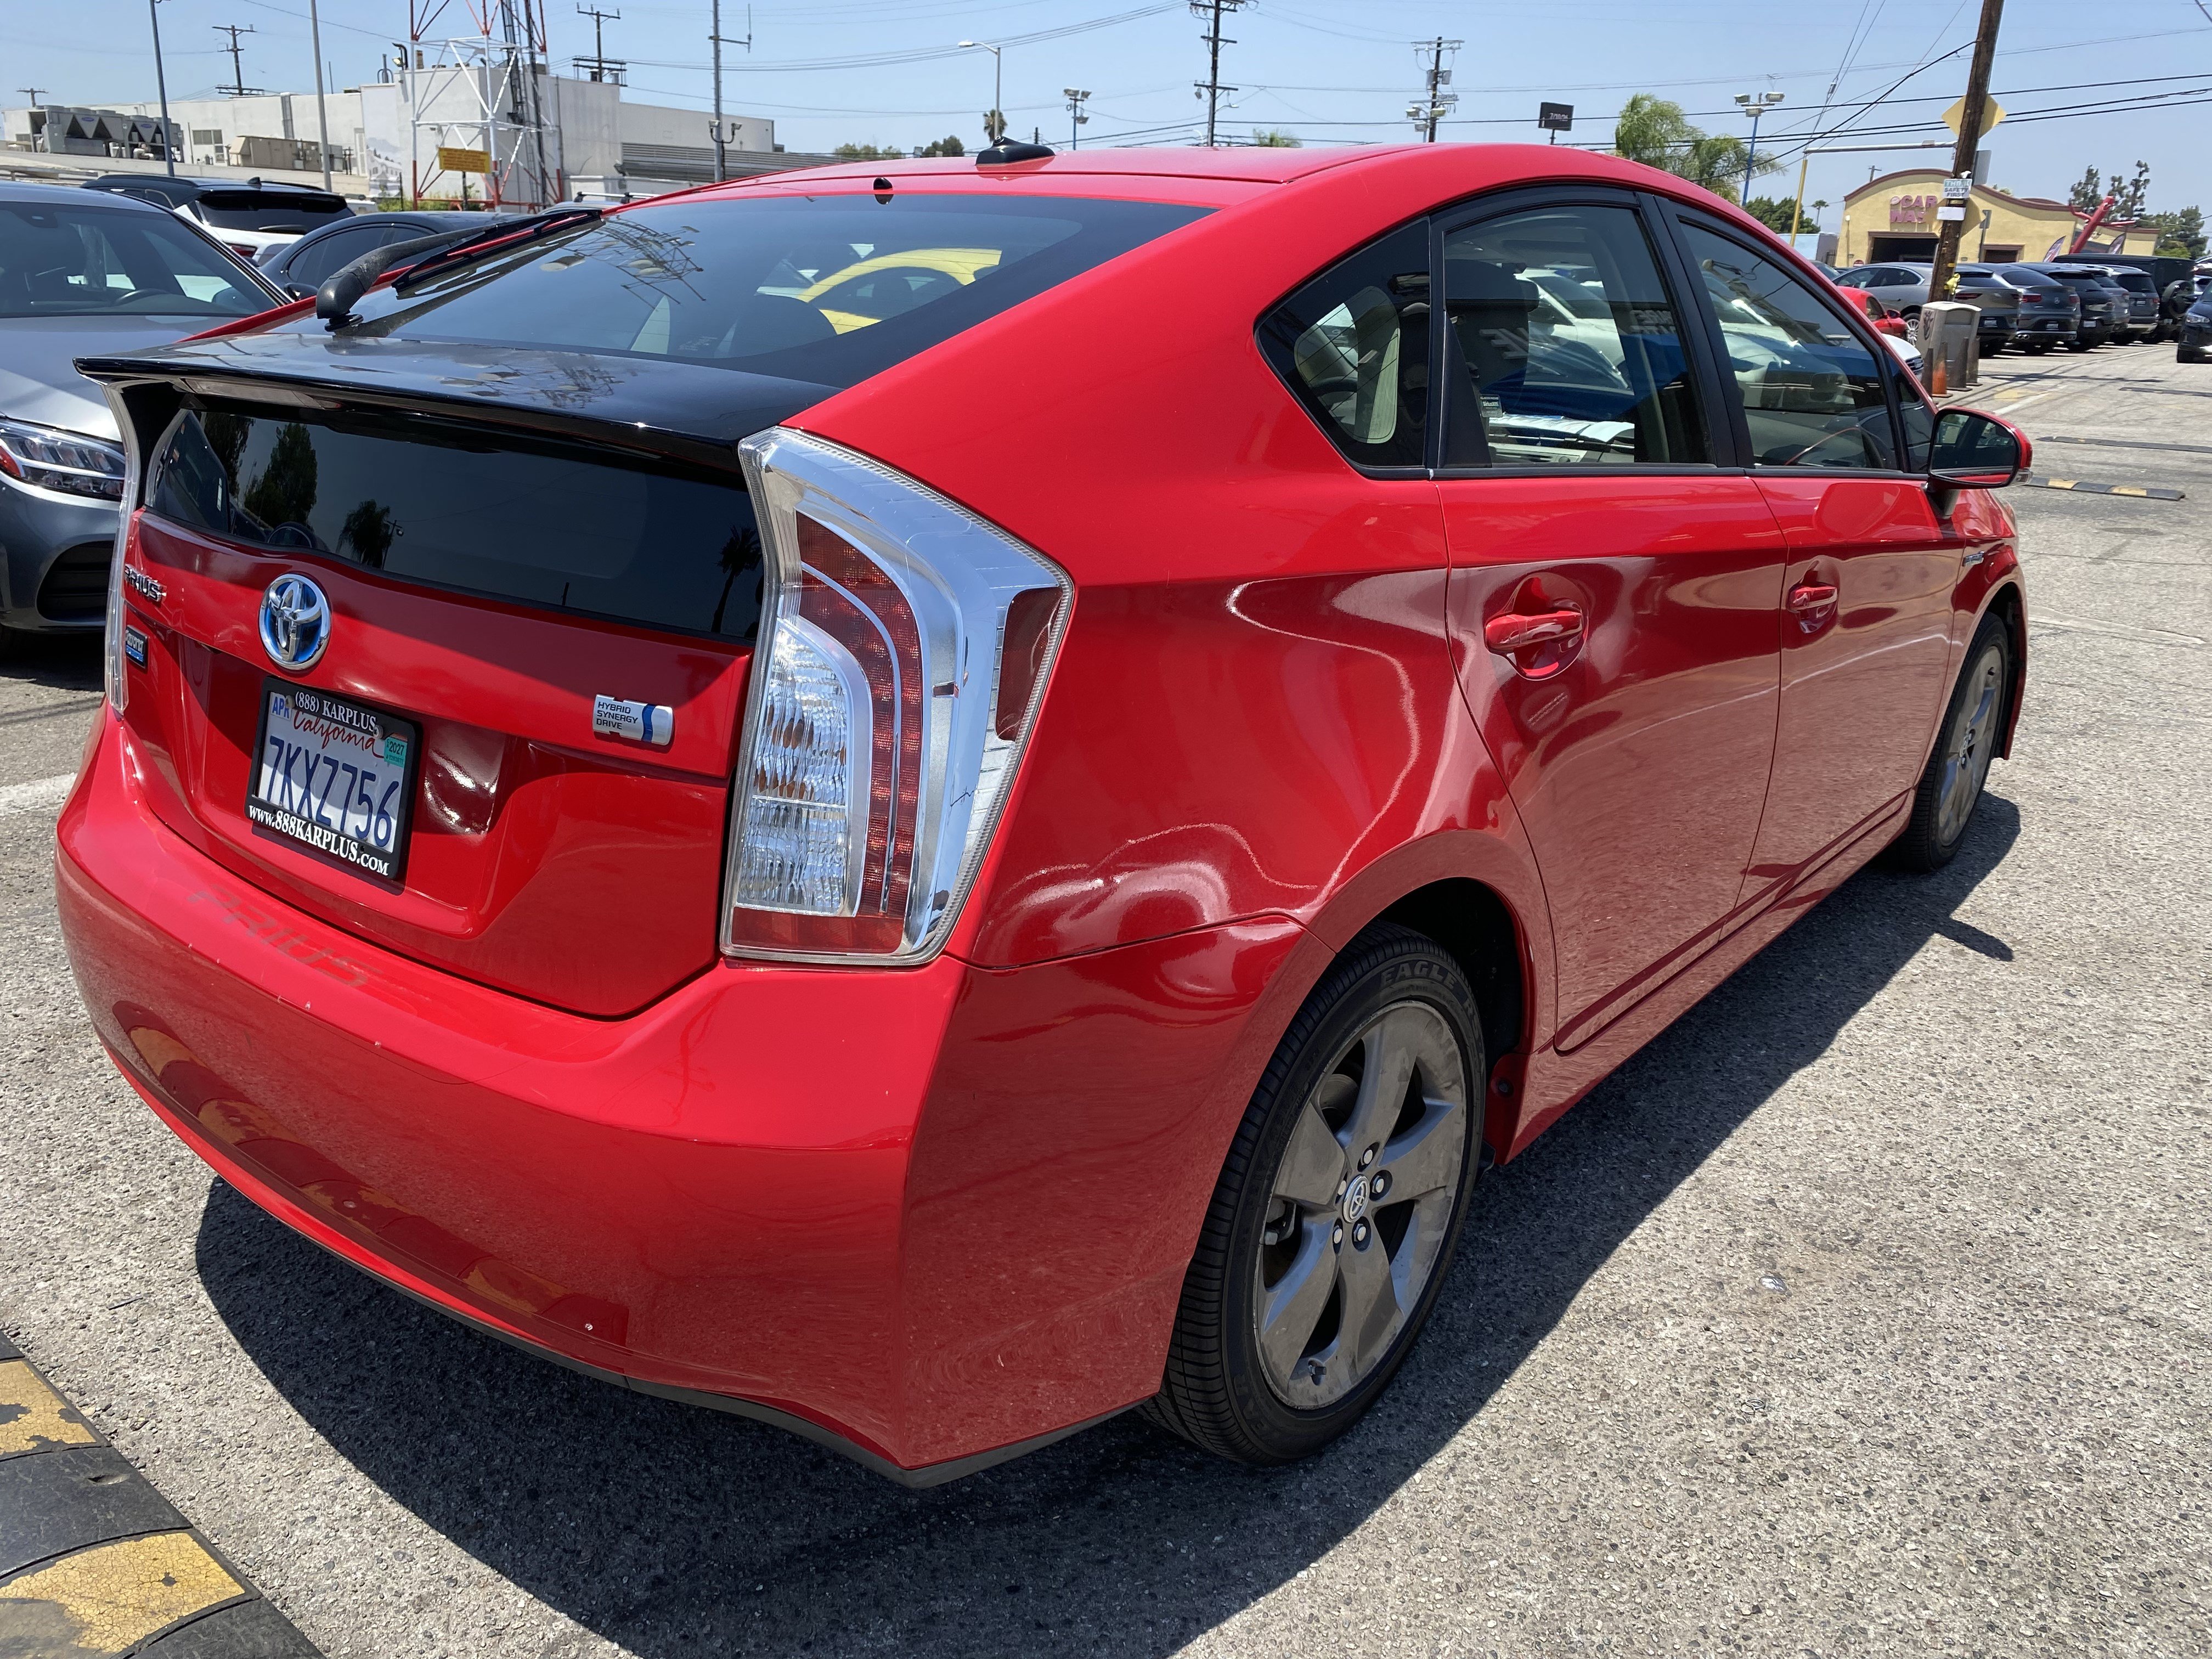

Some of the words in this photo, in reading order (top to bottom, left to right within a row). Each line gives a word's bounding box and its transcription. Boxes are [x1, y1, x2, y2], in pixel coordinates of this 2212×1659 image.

[1900, 195, 1938, 208] CAR
[295, 691, 320, 713] (888)
[322, 700, 376, 732] KARPLUS
[597, 710, 639, 724] SYNERGY
[598, 701, 631, 714] HYBRID
[294, 708, 385, 758] California
[596, 718, 623, 730] DRIVE
[388, 741, 405, 756] 2027
[267, 735, 399, 848] 7KXZ756
[187, 884, 385, 988] PRIUS
[1380, 960, 1458, 990] EAGLE
